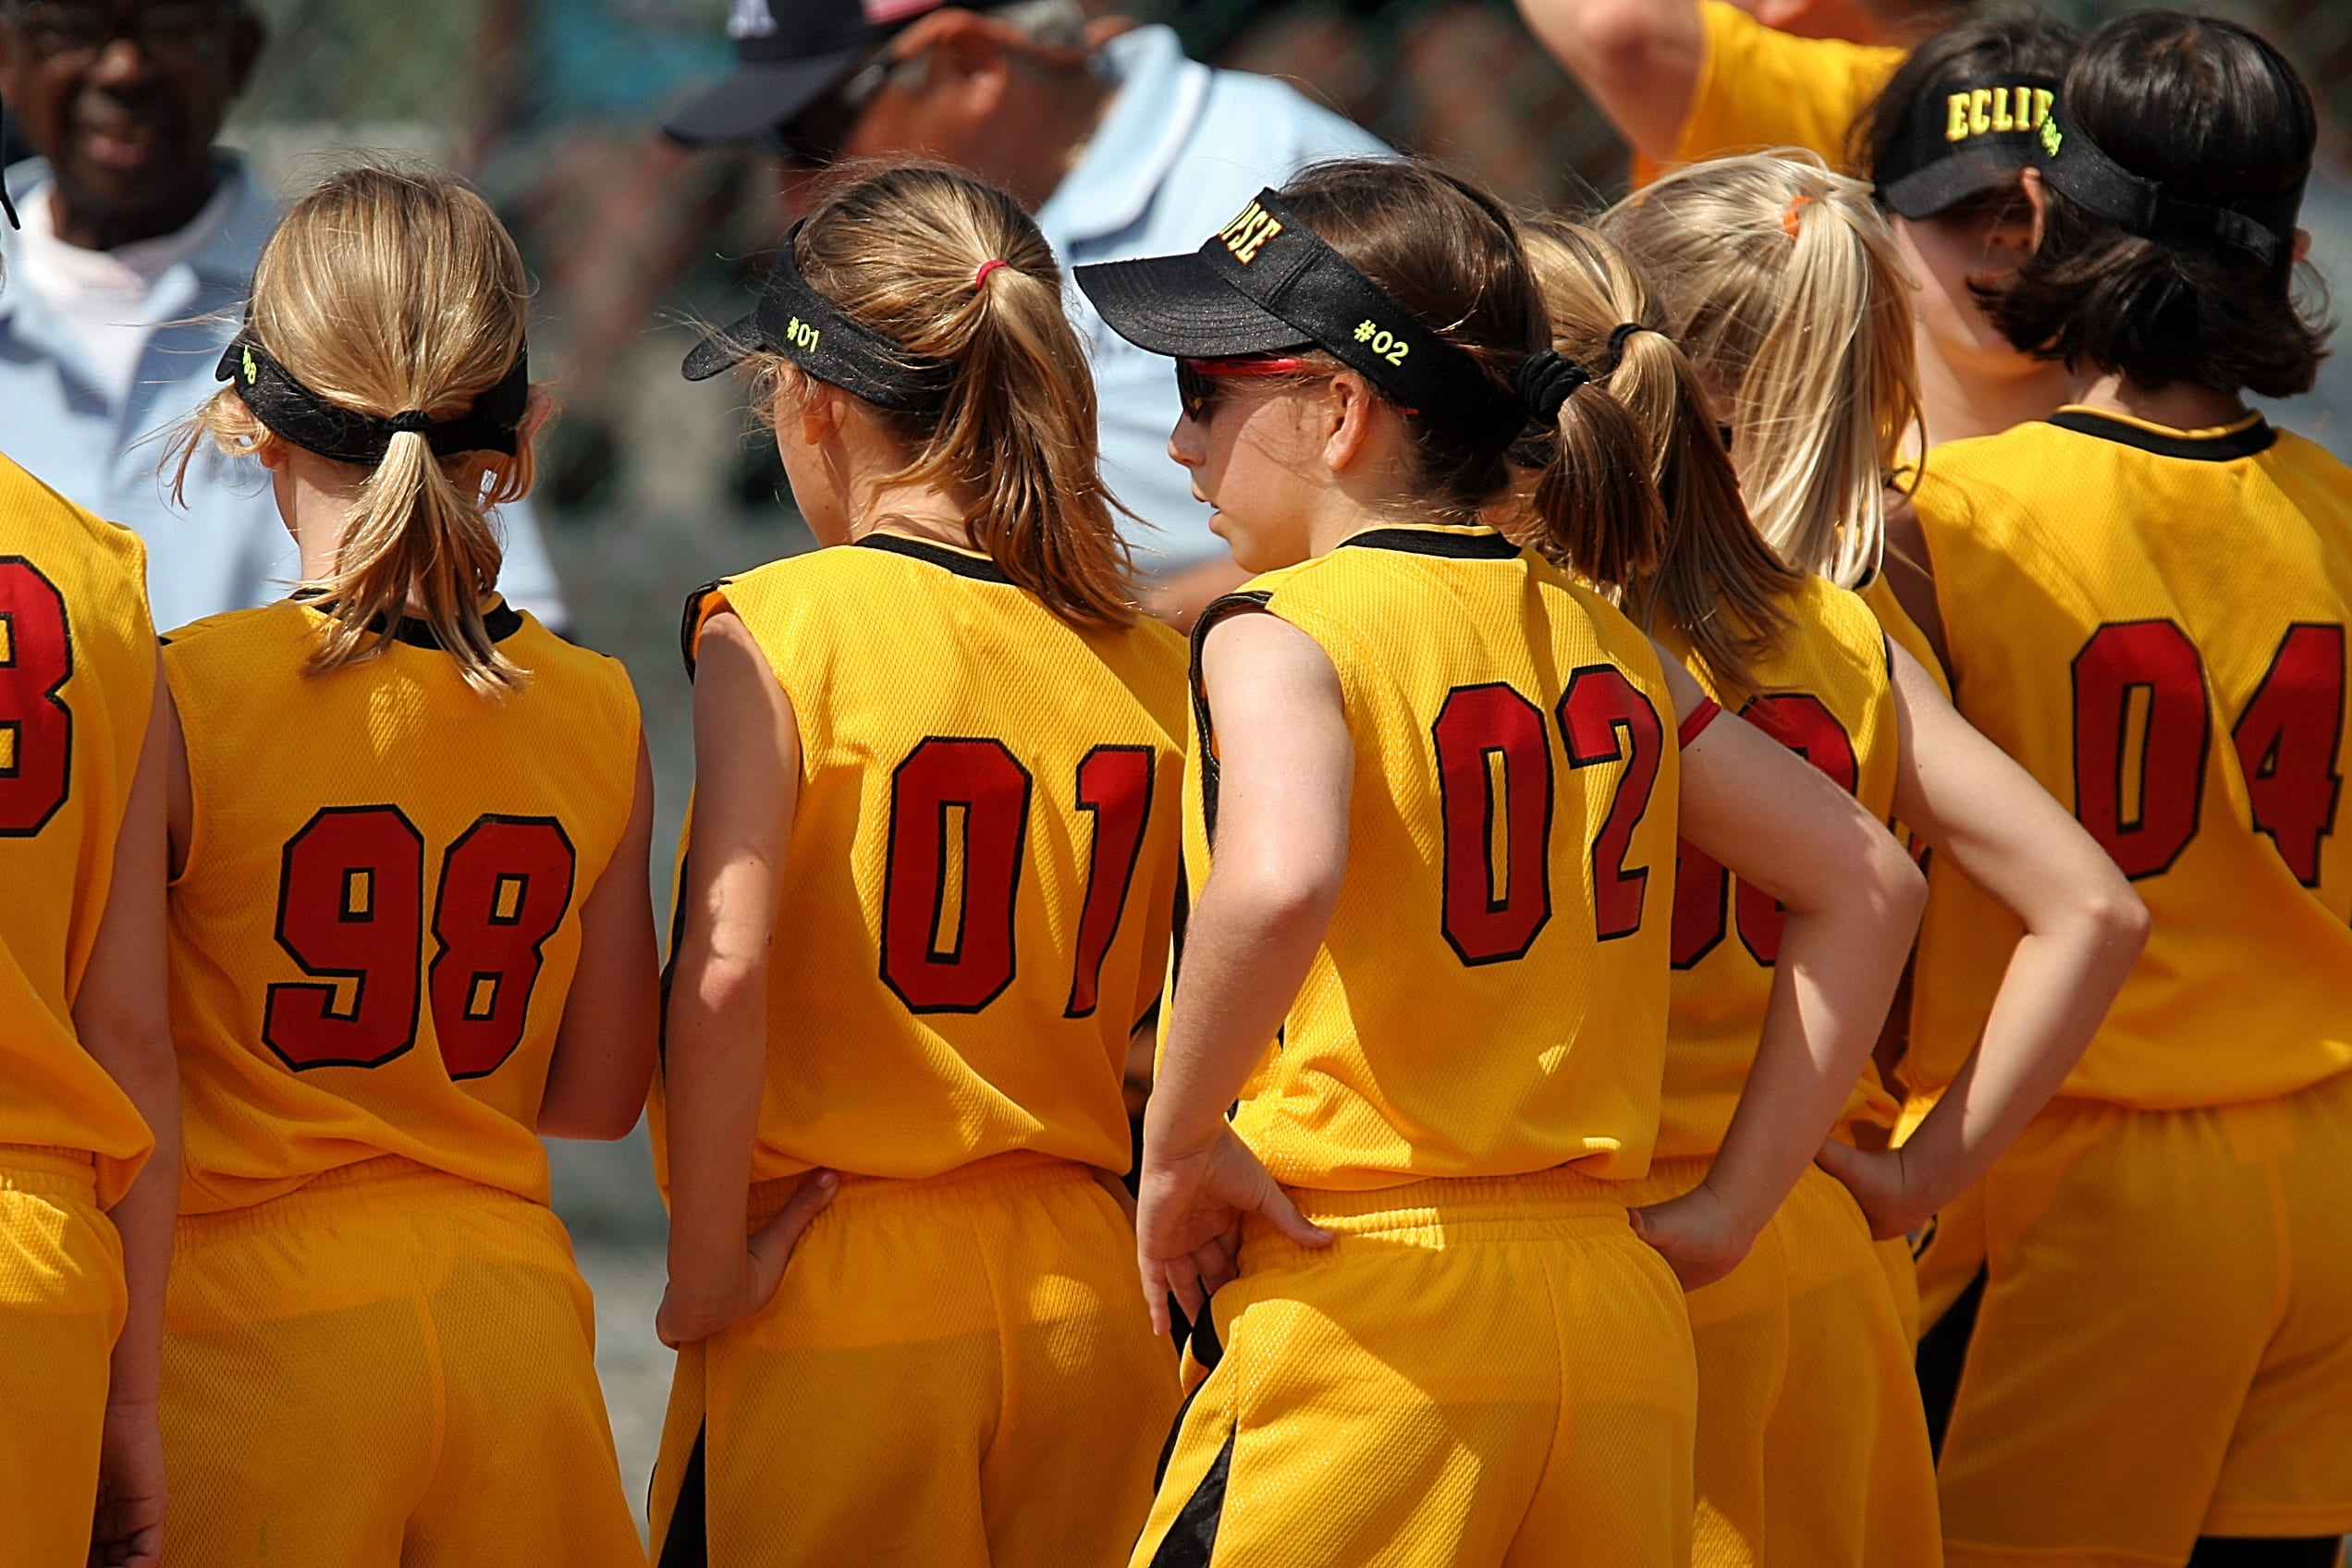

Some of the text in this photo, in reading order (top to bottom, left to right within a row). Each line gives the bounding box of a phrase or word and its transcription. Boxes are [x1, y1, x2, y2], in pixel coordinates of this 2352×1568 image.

[787, 316, 819, 352] #01
[1354, 320, 1409, 366] #02
[879, 736, 1156, 1018] 01
[1431, 664, 1663, 967] 02
[2071, 618, 2346, 888] 04
[262, 803, 576, 1081] 98
